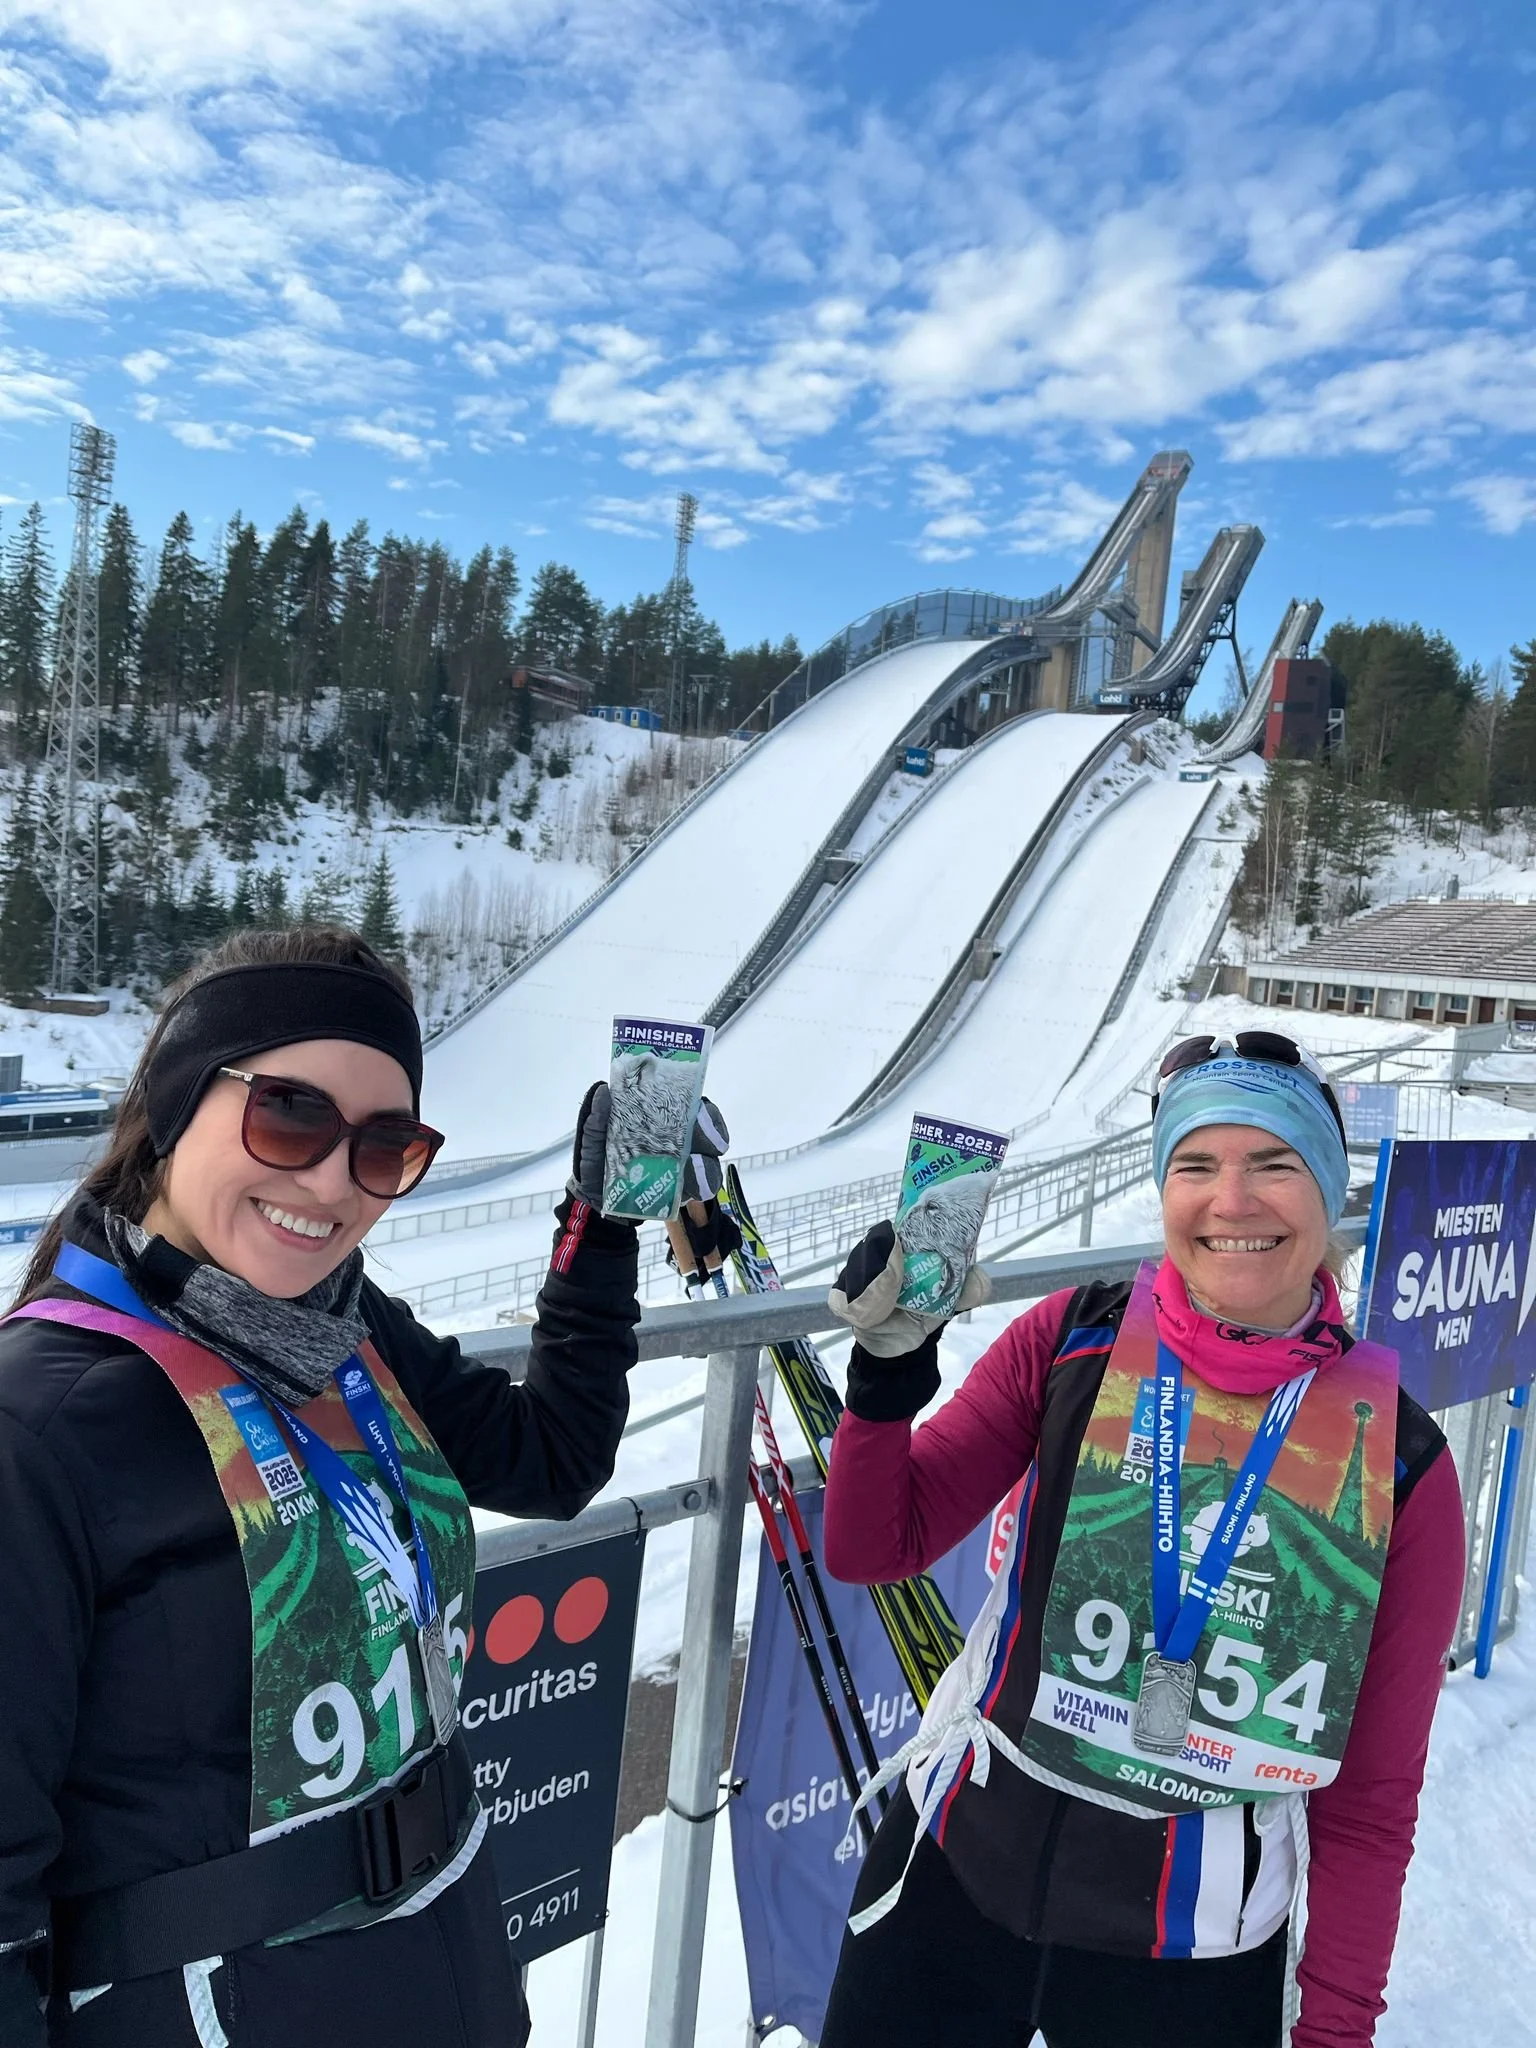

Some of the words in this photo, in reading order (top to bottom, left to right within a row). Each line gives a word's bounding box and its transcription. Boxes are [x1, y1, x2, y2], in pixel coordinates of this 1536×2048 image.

[1099, 692, 1123, 704] Lahti
[624, 1026, 693, 1045] FINISHER
[1184, 1061, 1300, 1088] CROSSCUT
[913, 1122, 943, 1139] SHER
[954, 1132, 993, 1152] 2025
[912, 1153, 955, 1186] FINSKI
[634, 1169, 674, 1209] FINSKI
[1433, 1202, 1504, 1239] MIESTEN
[1392, 1239, 1517, 1322] SAUNA
[1434, 1314, 1473, 1351] MEN
[345, 1382, 371, 1398] FINSKI
[1131, 1442, 1155, 1461] 20
[1158, 1376, 1176, 1552] FINLANDIA-HIIHTO
[265, 1463, 299, 1492] 2025
[1120, 1464, 1147, 1484] 20
[277, 1500, 299, 1527] 20
[295, 1491, 320, 1517] KM
[1221, 1514, 1240, 1545] SUOMI
[1234, 1472, 1257, 1512] FINLAND
[364, 1575, 409, 1625] FIN
[1070, 1599, 1329, 1745] 954
[292, 1592, 469, 1799] 915
[456, 1661, 598, 1730] curitas
[1056, 1688, 1129, 1726] VITAMIN
[1053, 1704, 1096, 1734] WELL
[1186, 1733, 1234, 1760] NTER
[1115, 1763, 1236, 1805] SALOMON
[1254, 1762, 1318, 1785] renta
[483, 1769, 590, 1825] rbjuden
[506, 1913, 522, 1941] 0
[529, 1886, 580, 1929] 4911
